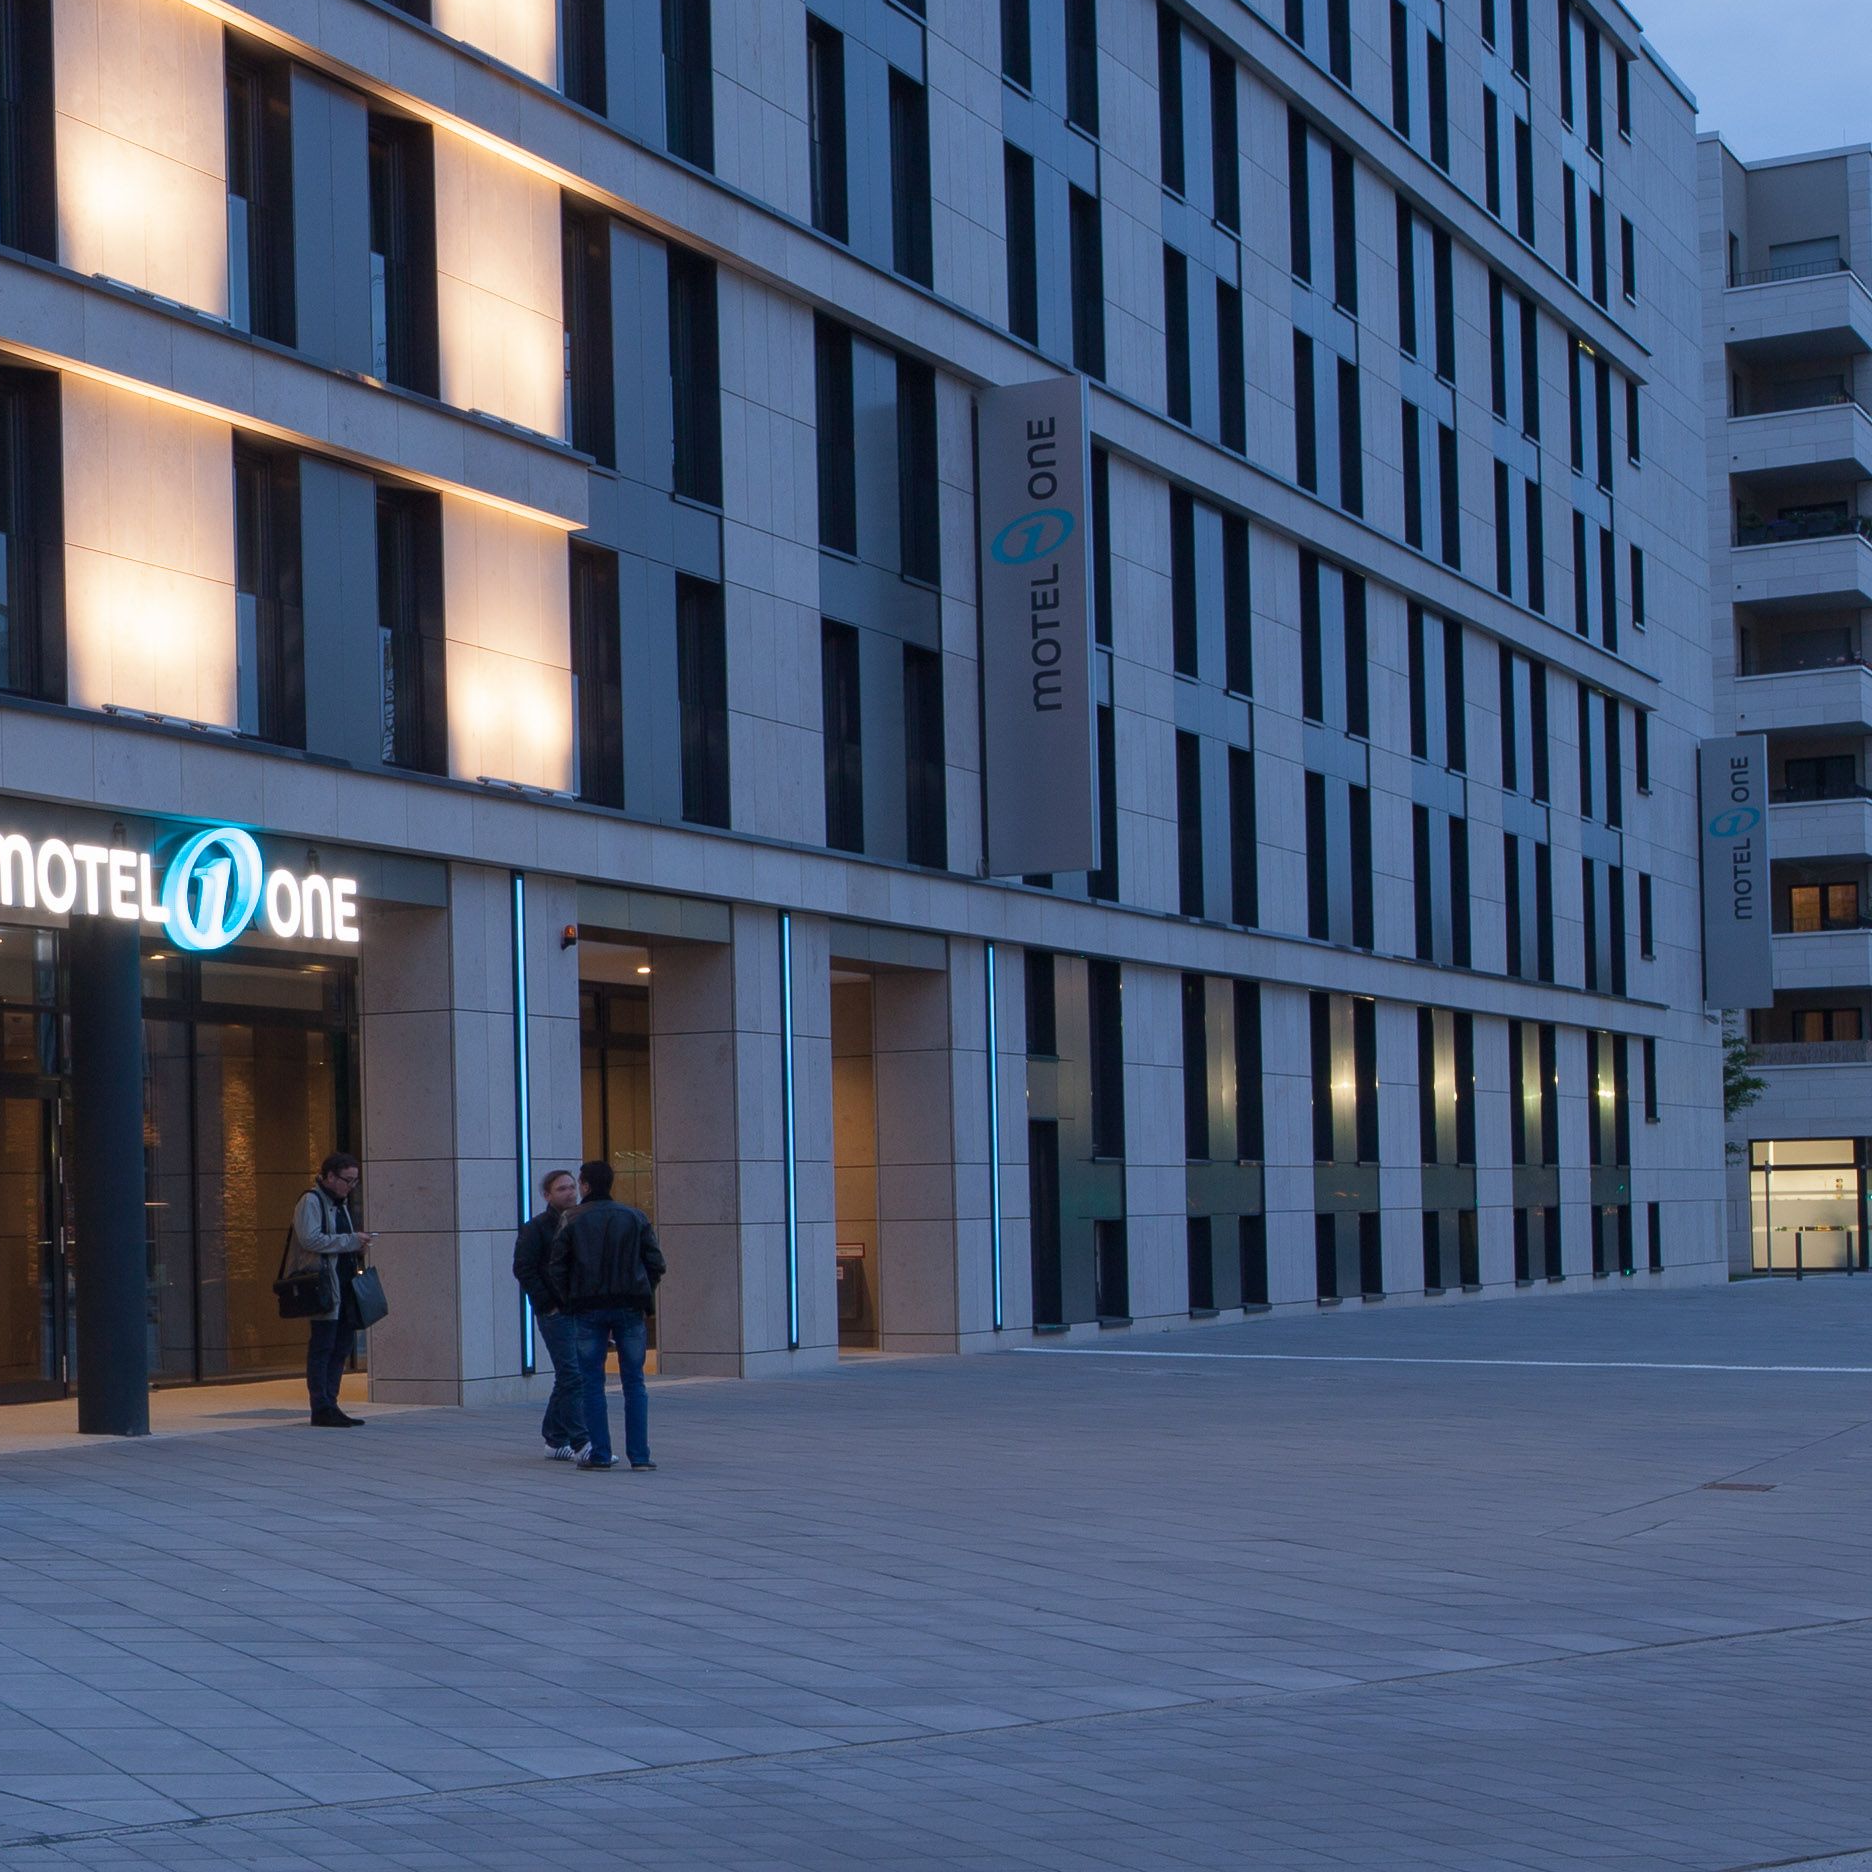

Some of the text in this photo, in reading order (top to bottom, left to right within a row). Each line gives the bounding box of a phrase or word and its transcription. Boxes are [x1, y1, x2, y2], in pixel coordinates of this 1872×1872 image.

[1026, 416, 1057, 501] ONE
[1031, 562, 1062, 713] MOTEL
[1730, 755, 1750, 803] ONE
[266, 868, 359, 943] ONE
[1732, 837, 1753, 921] MOTEL
